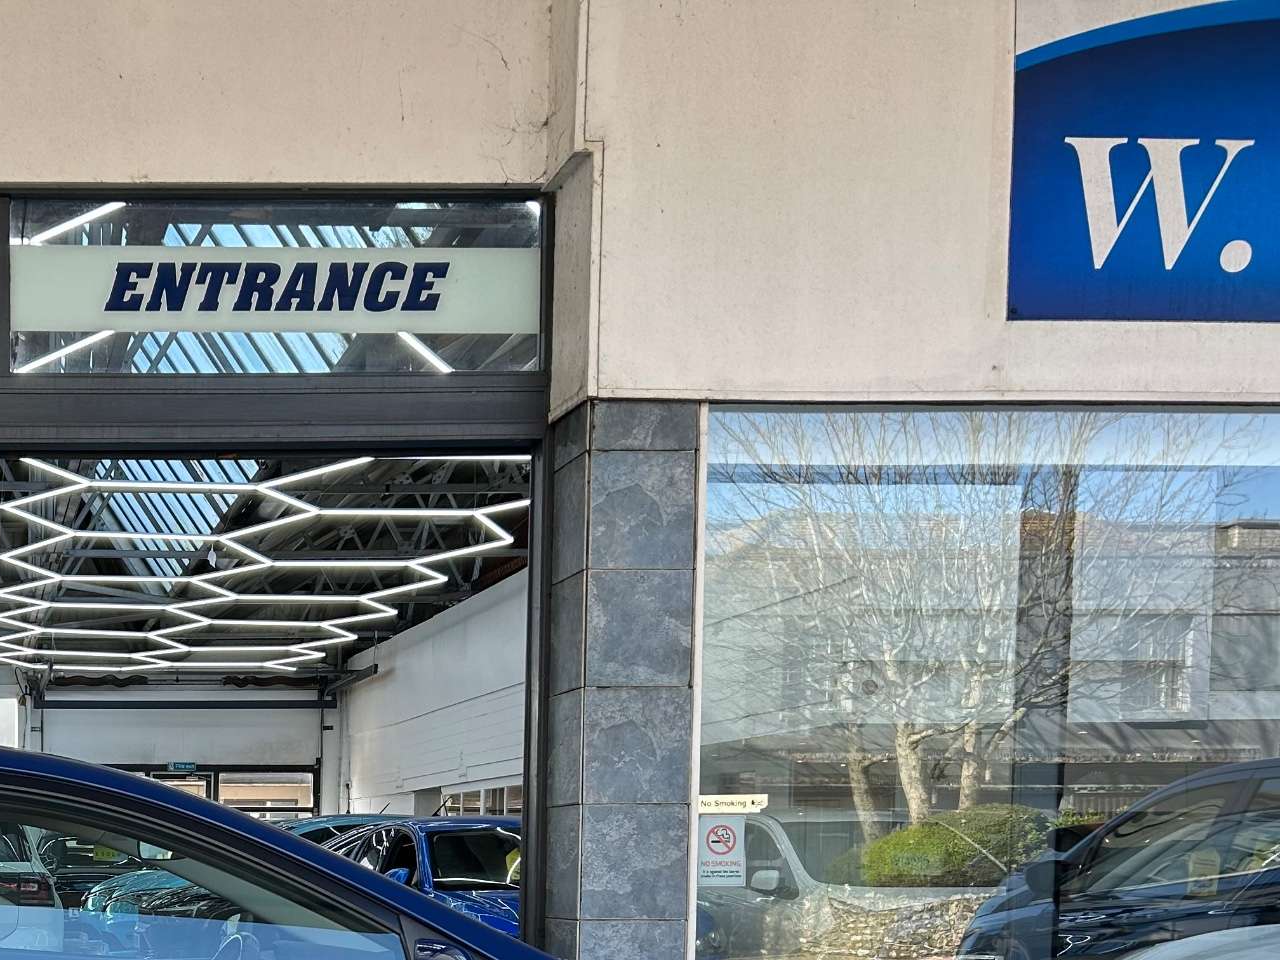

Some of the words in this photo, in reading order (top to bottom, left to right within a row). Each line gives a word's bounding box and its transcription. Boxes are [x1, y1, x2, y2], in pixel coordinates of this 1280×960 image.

[1063, 136, 1256, 273] W.
[103, 261, 451, 313] ENTRANCE
[700, 800, 712, 808] No
[714, 800, 747, 809] Smoking
